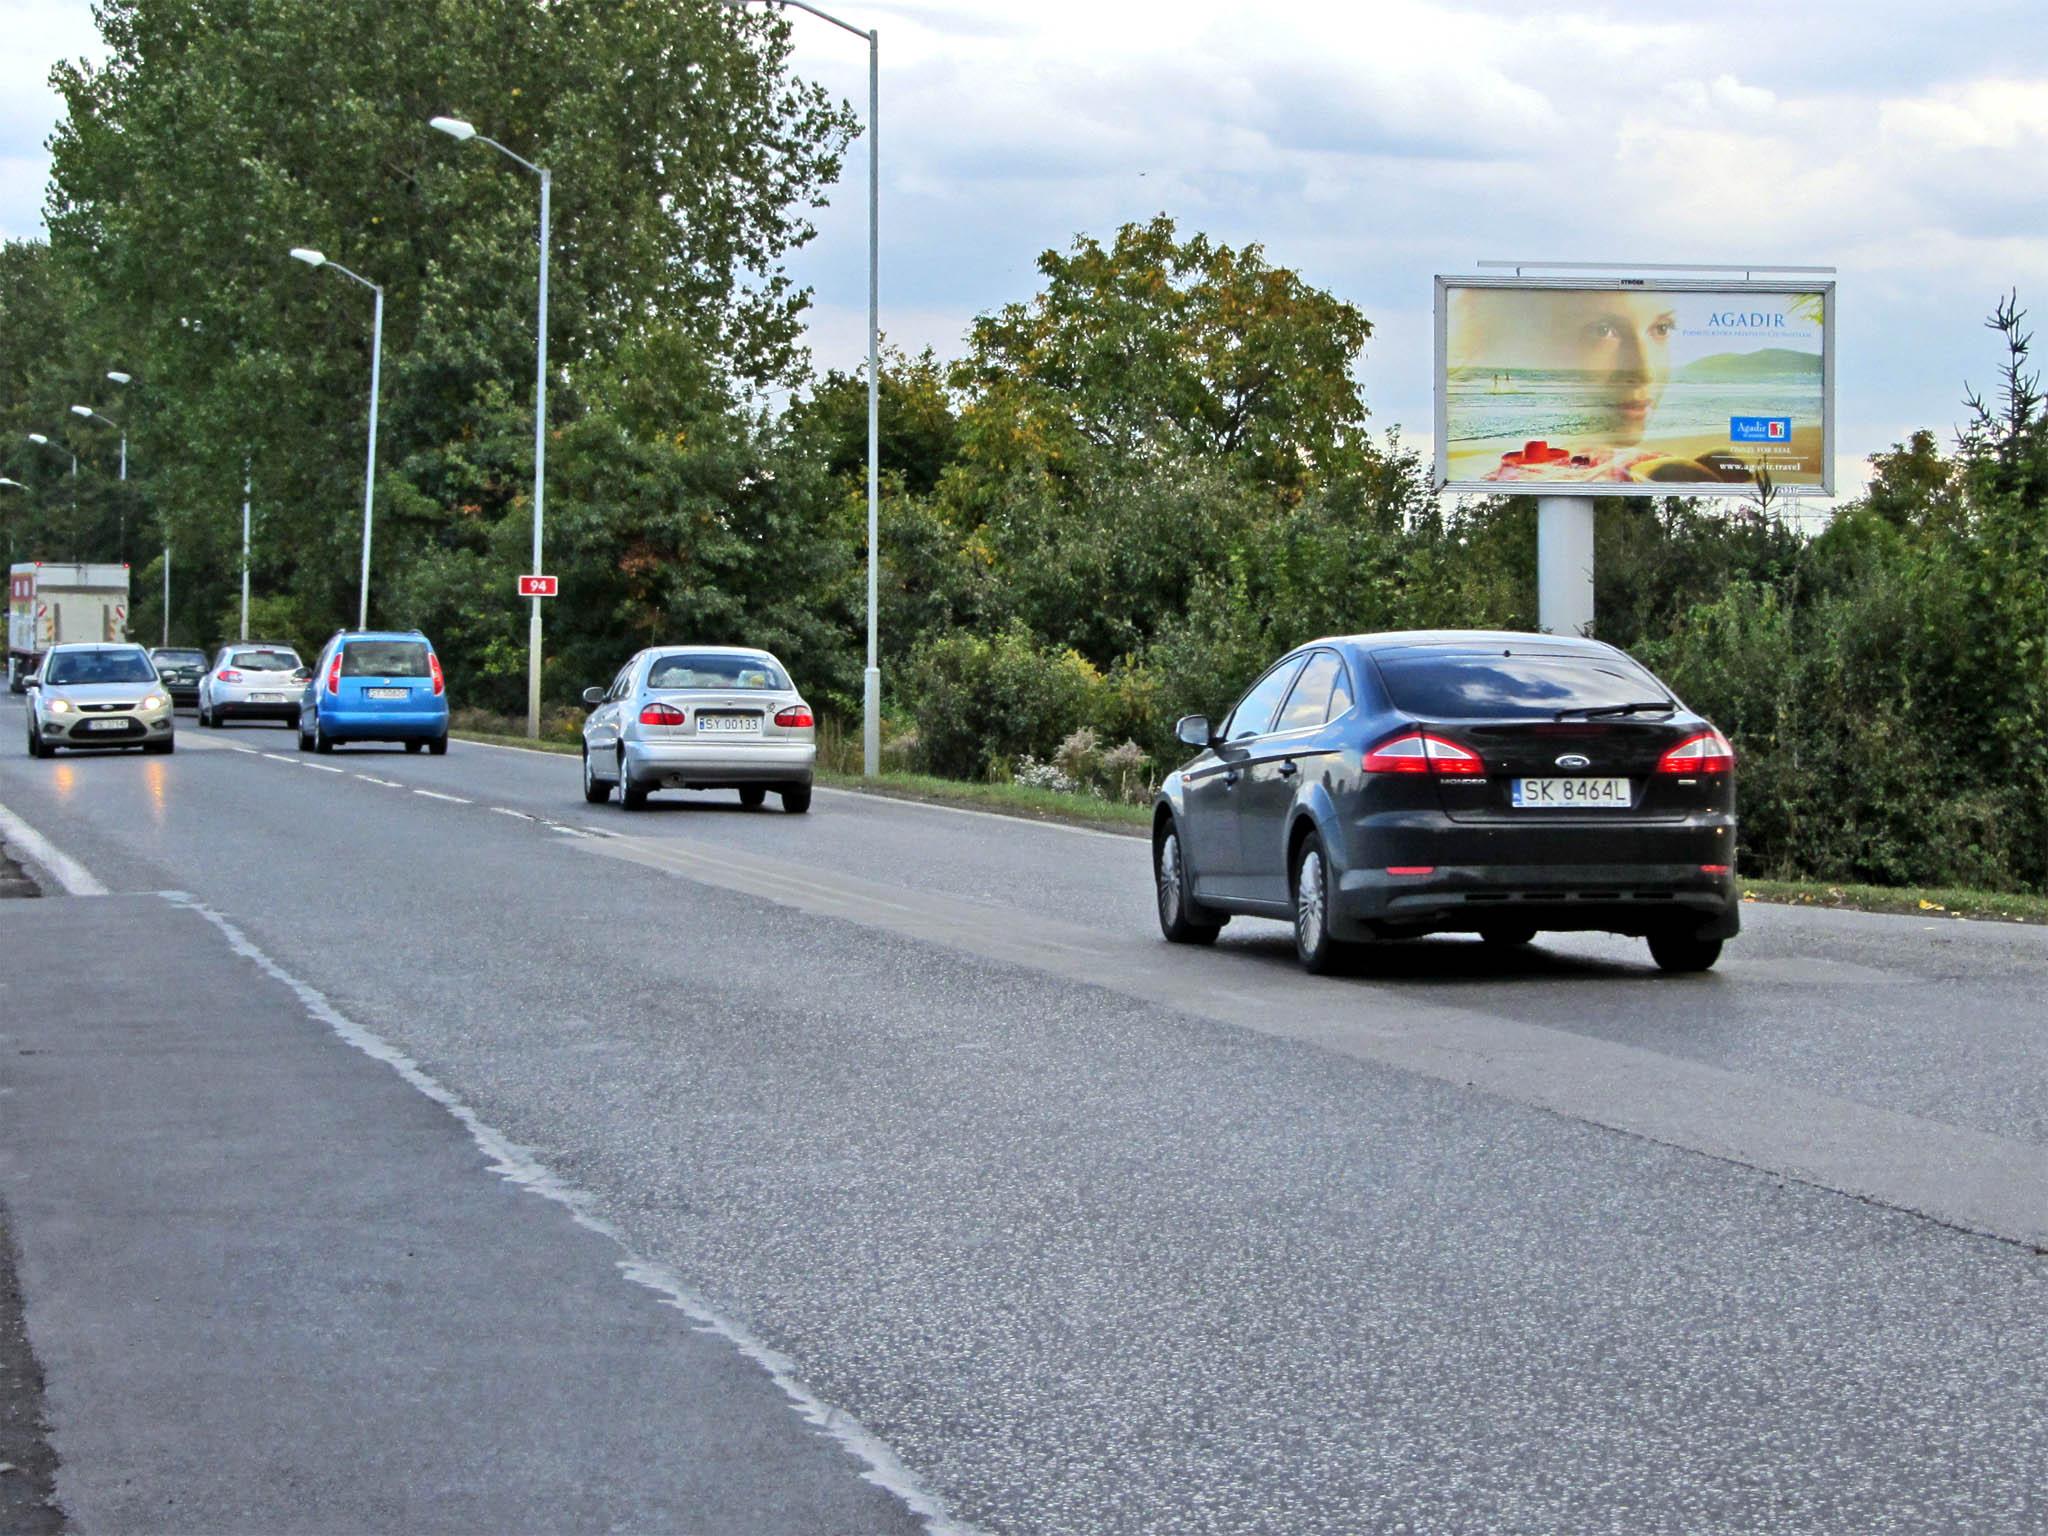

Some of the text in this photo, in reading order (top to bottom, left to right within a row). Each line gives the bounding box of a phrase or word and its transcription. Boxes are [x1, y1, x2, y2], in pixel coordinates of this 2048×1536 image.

[1709, 312, 1785, 327] AGADIR
[1737, 421, 1767, 434] Agadir
[530, 580, 547, 592] 94
[706, 719, 758, 730] SY 00133
[1525, 780, 1626, 801] SK 8464L
